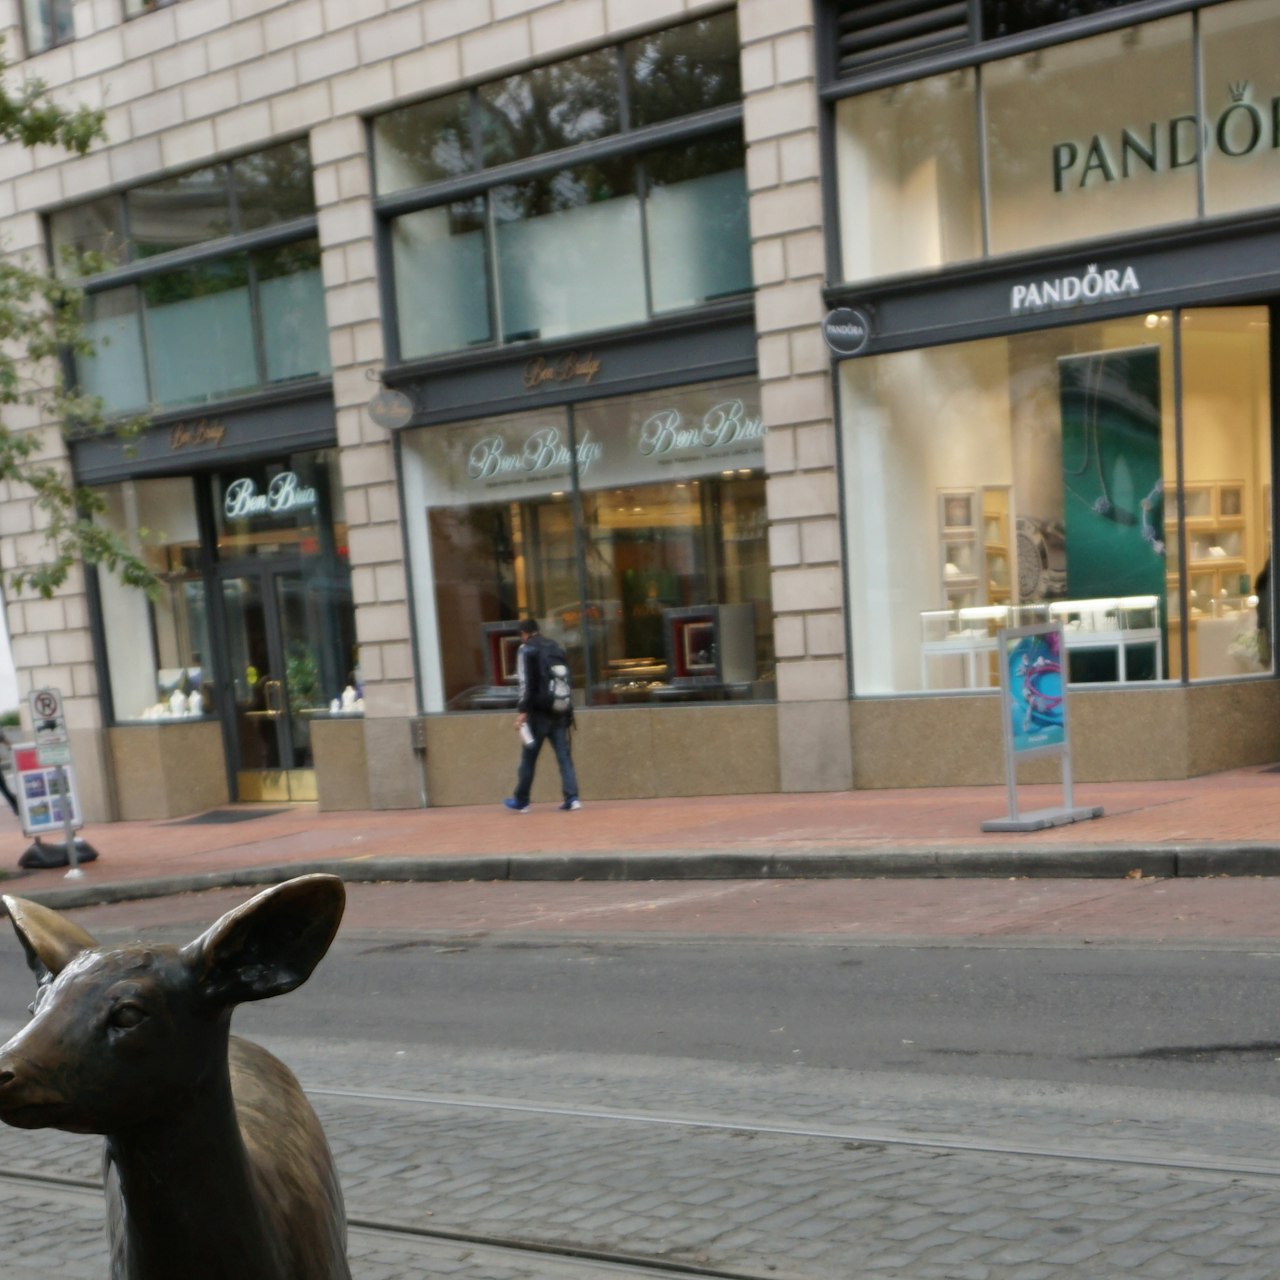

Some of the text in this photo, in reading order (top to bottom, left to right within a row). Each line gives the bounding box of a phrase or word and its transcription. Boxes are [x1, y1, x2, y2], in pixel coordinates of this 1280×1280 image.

[1011, 264, 1140, 309] PANDORA
[524, 357, 554, 388] Ben
[470, 425, 604, 480] Ben Bridge
[639, 408, 701, 456] Ben
[224, 477, 268, 518] Ben
